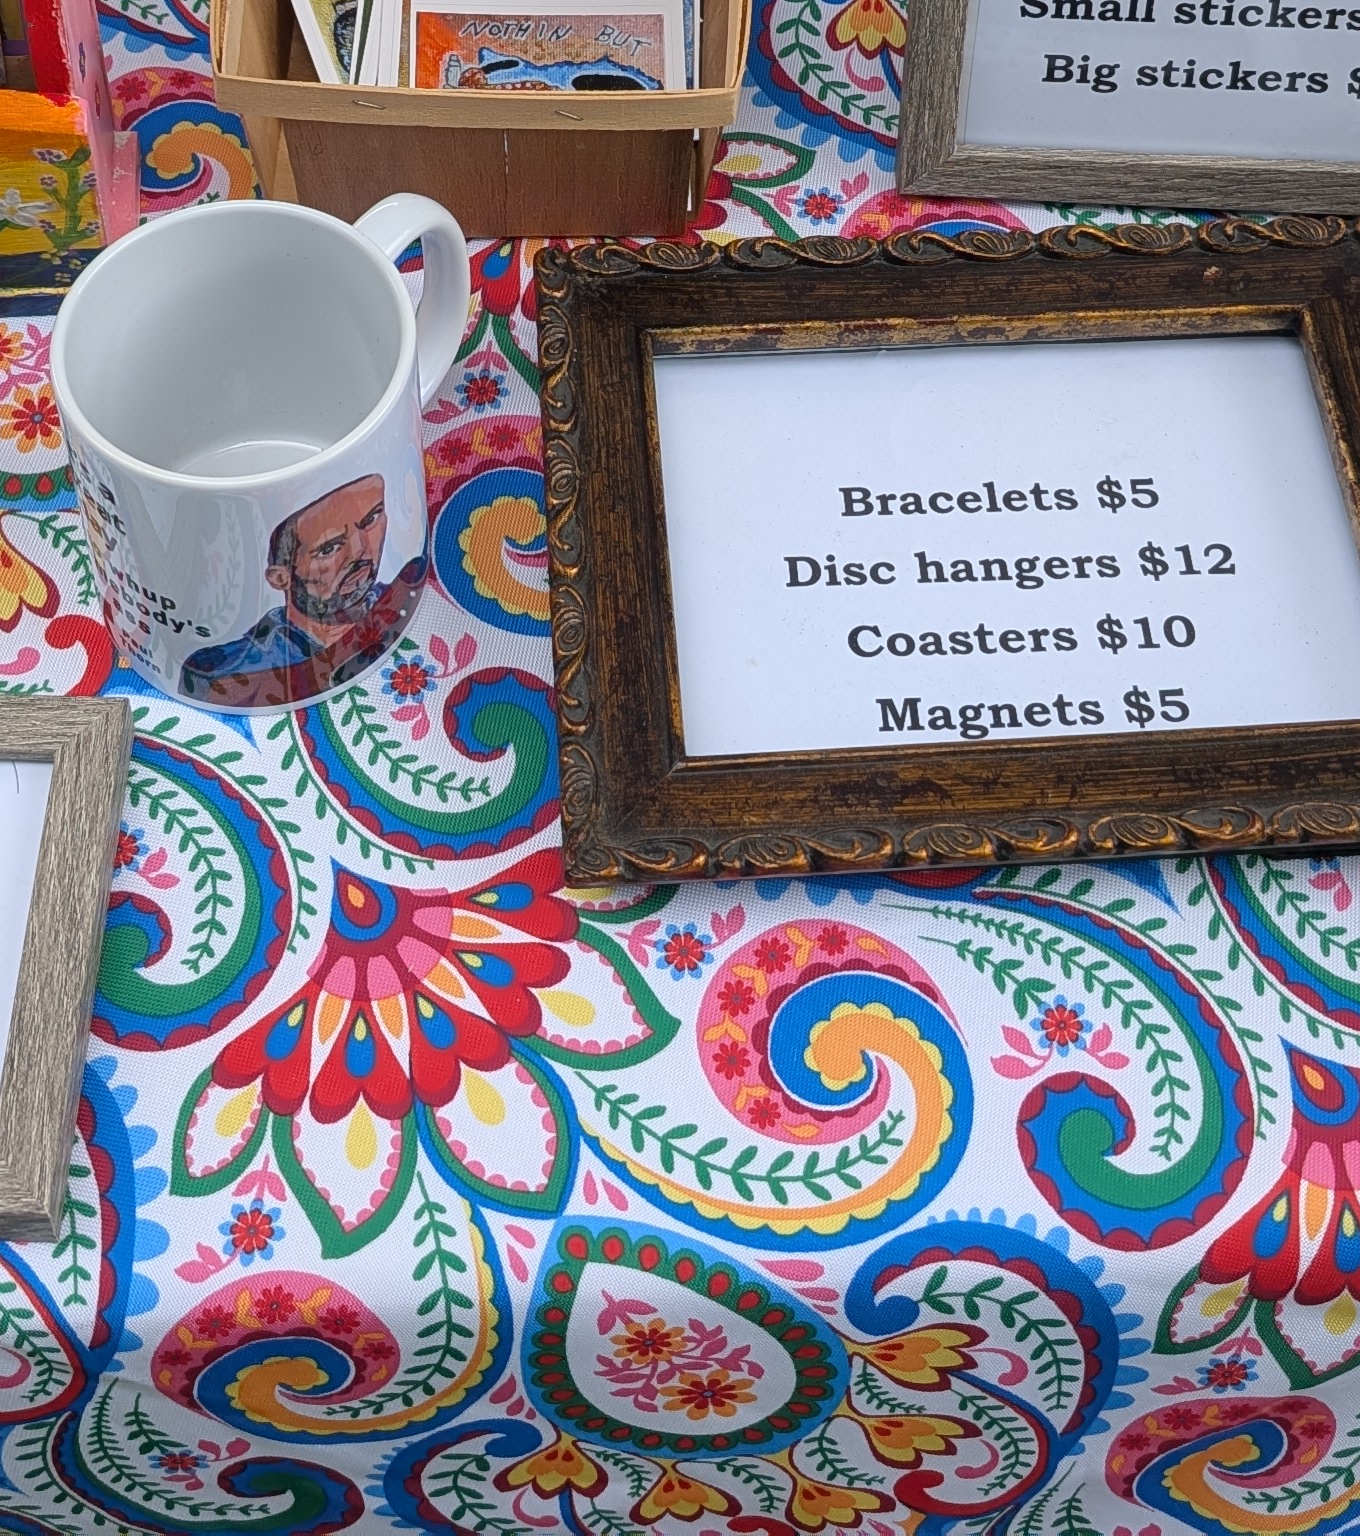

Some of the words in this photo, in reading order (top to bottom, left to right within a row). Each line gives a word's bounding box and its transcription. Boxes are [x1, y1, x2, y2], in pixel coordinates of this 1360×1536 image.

[460, 21, 573, 42] NOTHIN
[594, 24, 652, 57] BUT
[1041, 54, 1120, 95] Big
[1135, 59, 1330, 95] stickers
[838, 480, 1080, 517] Bracelets
[1096, 474, 1160, 514] $5
[783, 553, 897, 588] Disc
[913, 550, 1122, 591] hangers
[1136, 540, 1237, 582] $12
[112, 597, 152, 635] ass
[846, 621, 1079, 659] Coasters
[1095, 612, 1197, 656] $10
[118, 633, 162, 674] Thorn
[121, 628, 154, 659] Paul
[875, 693, 1105, 741] Magnets
[1123, 684, 1191, 729] $5
